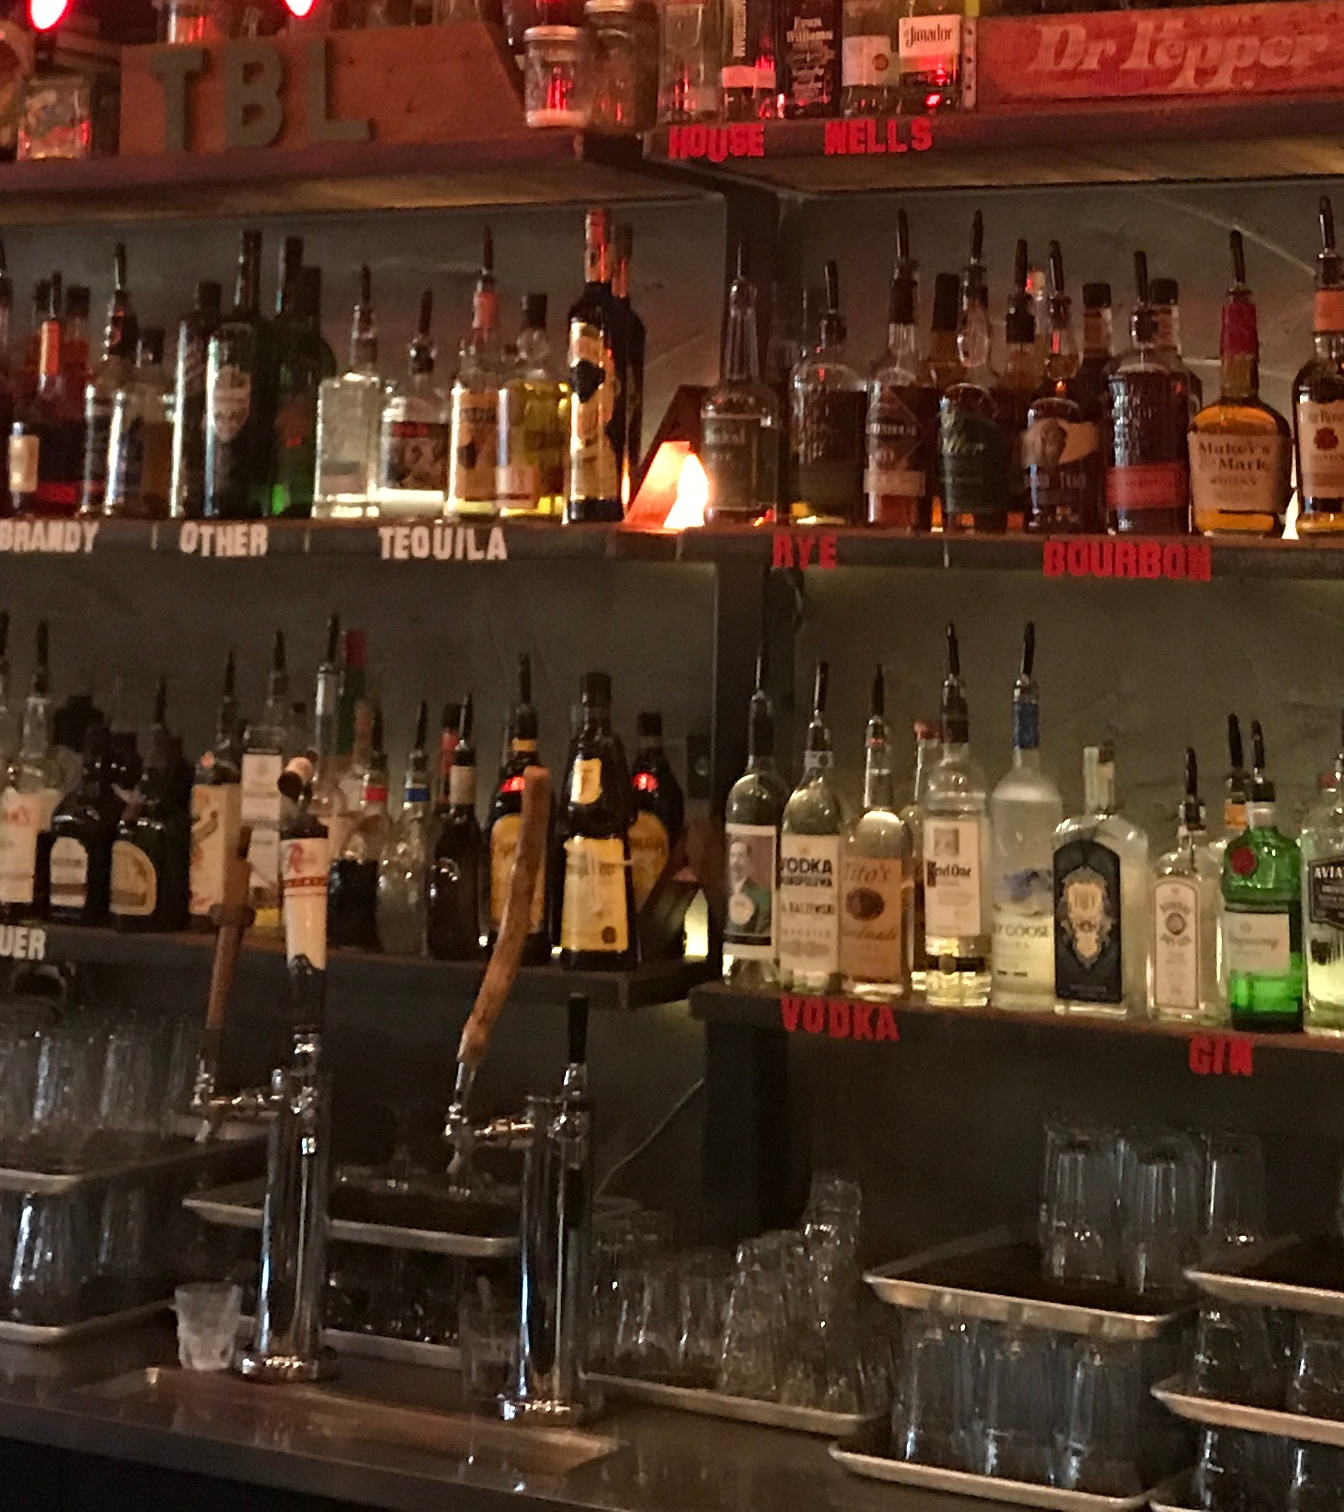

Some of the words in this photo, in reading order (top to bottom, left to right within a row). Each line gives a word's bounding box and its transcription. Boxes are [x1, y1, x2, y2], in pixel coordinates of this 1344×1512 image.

[1027, 21, 1117, 72] Dr
[147, 36, 373, 154] TBL
[668, 122, 766, 164] HOUSE
[824, 117, 933, 157] WELLS
[178, 521, 269, 559] OTHER
[377, 524, 509, 563] TEQUILA
[771, 533, 838, 569] RYE
[1042, 541, 1213, 582] BOURBON
[779, 856, 833, 876] VODKA
[780, 993, 901, 1042] VODKA
[1188, 1033, 1254, 1077] GIN
